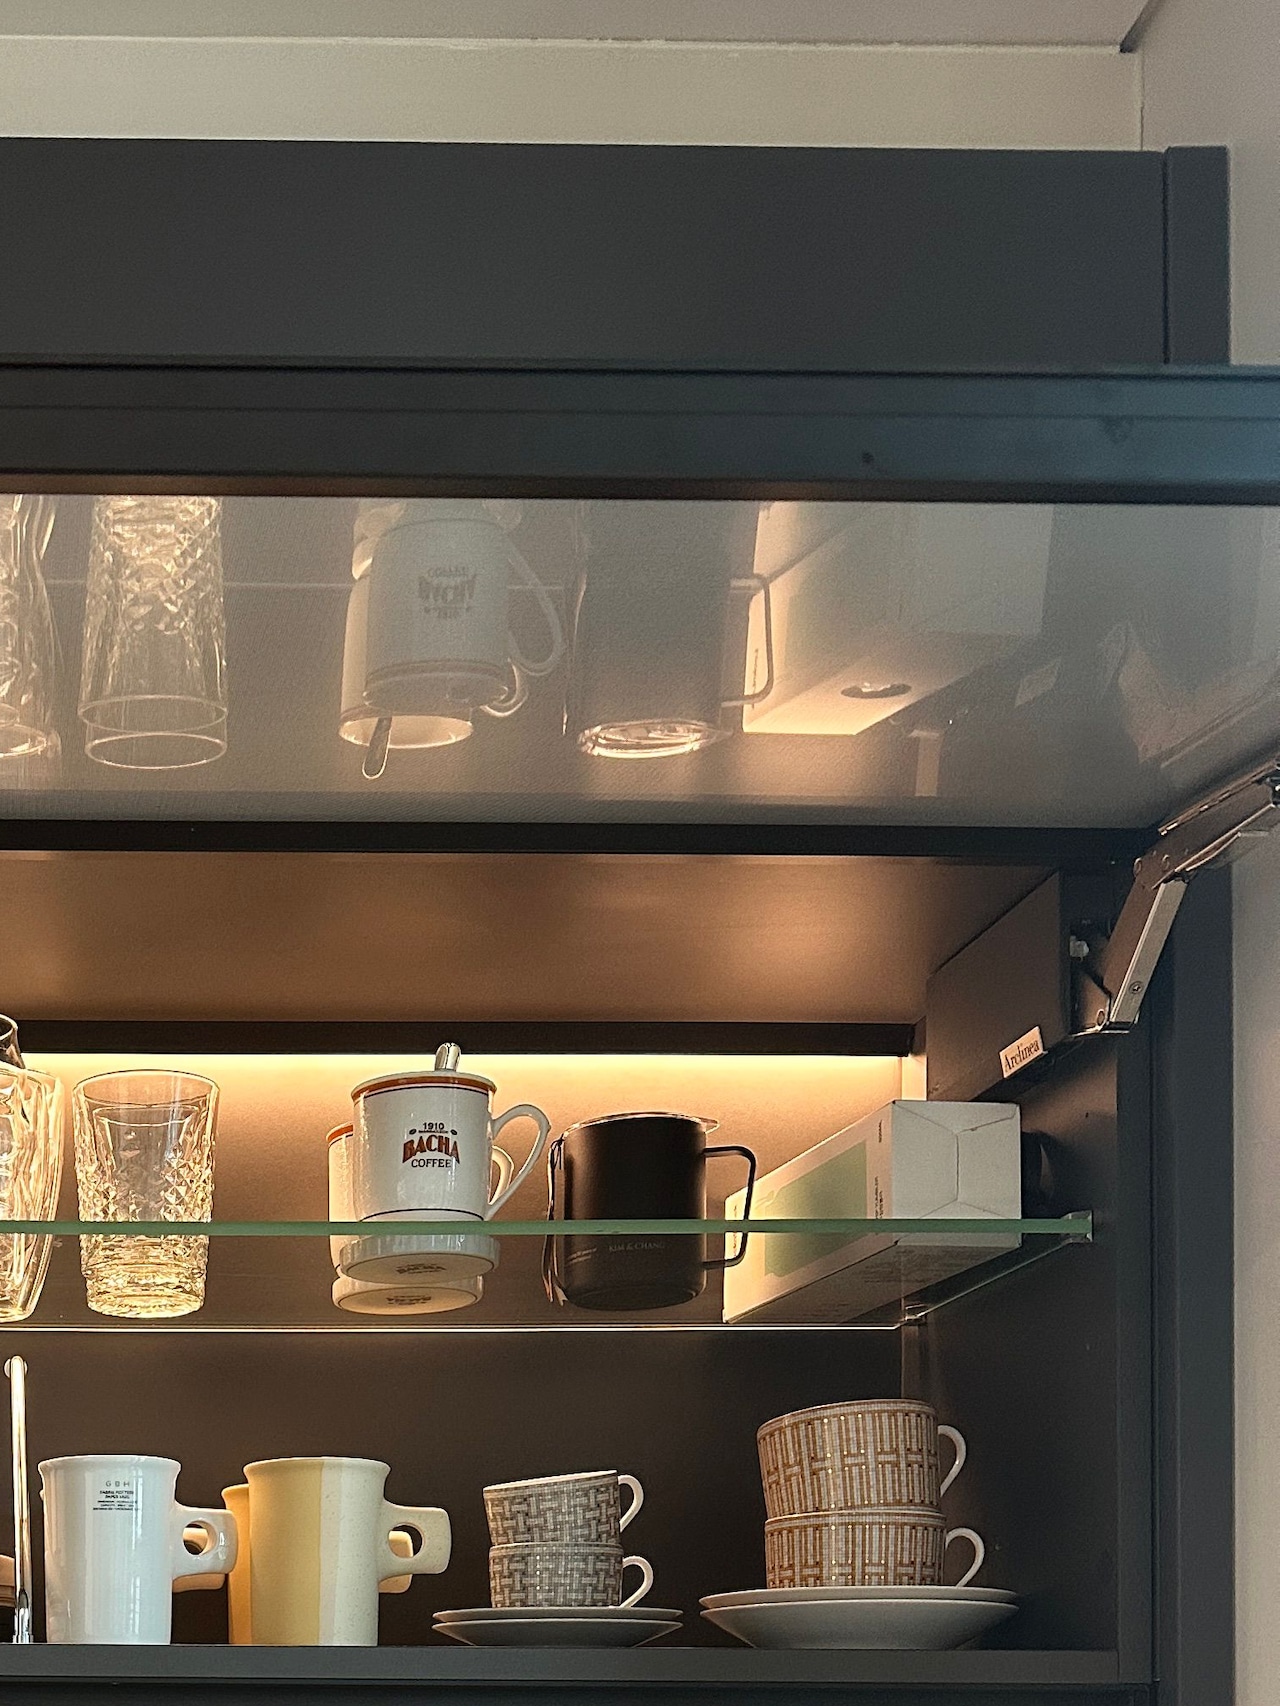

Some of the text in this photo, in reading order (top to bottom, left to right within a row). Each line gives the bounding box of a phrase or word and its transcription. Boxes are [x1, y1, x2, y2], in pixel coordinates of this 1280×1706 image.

[423, 1122, 445, 1130] 1910
[403, 1134, 460, 1164] BACHA
[411, 1159, 452, 1168] COFFEE
